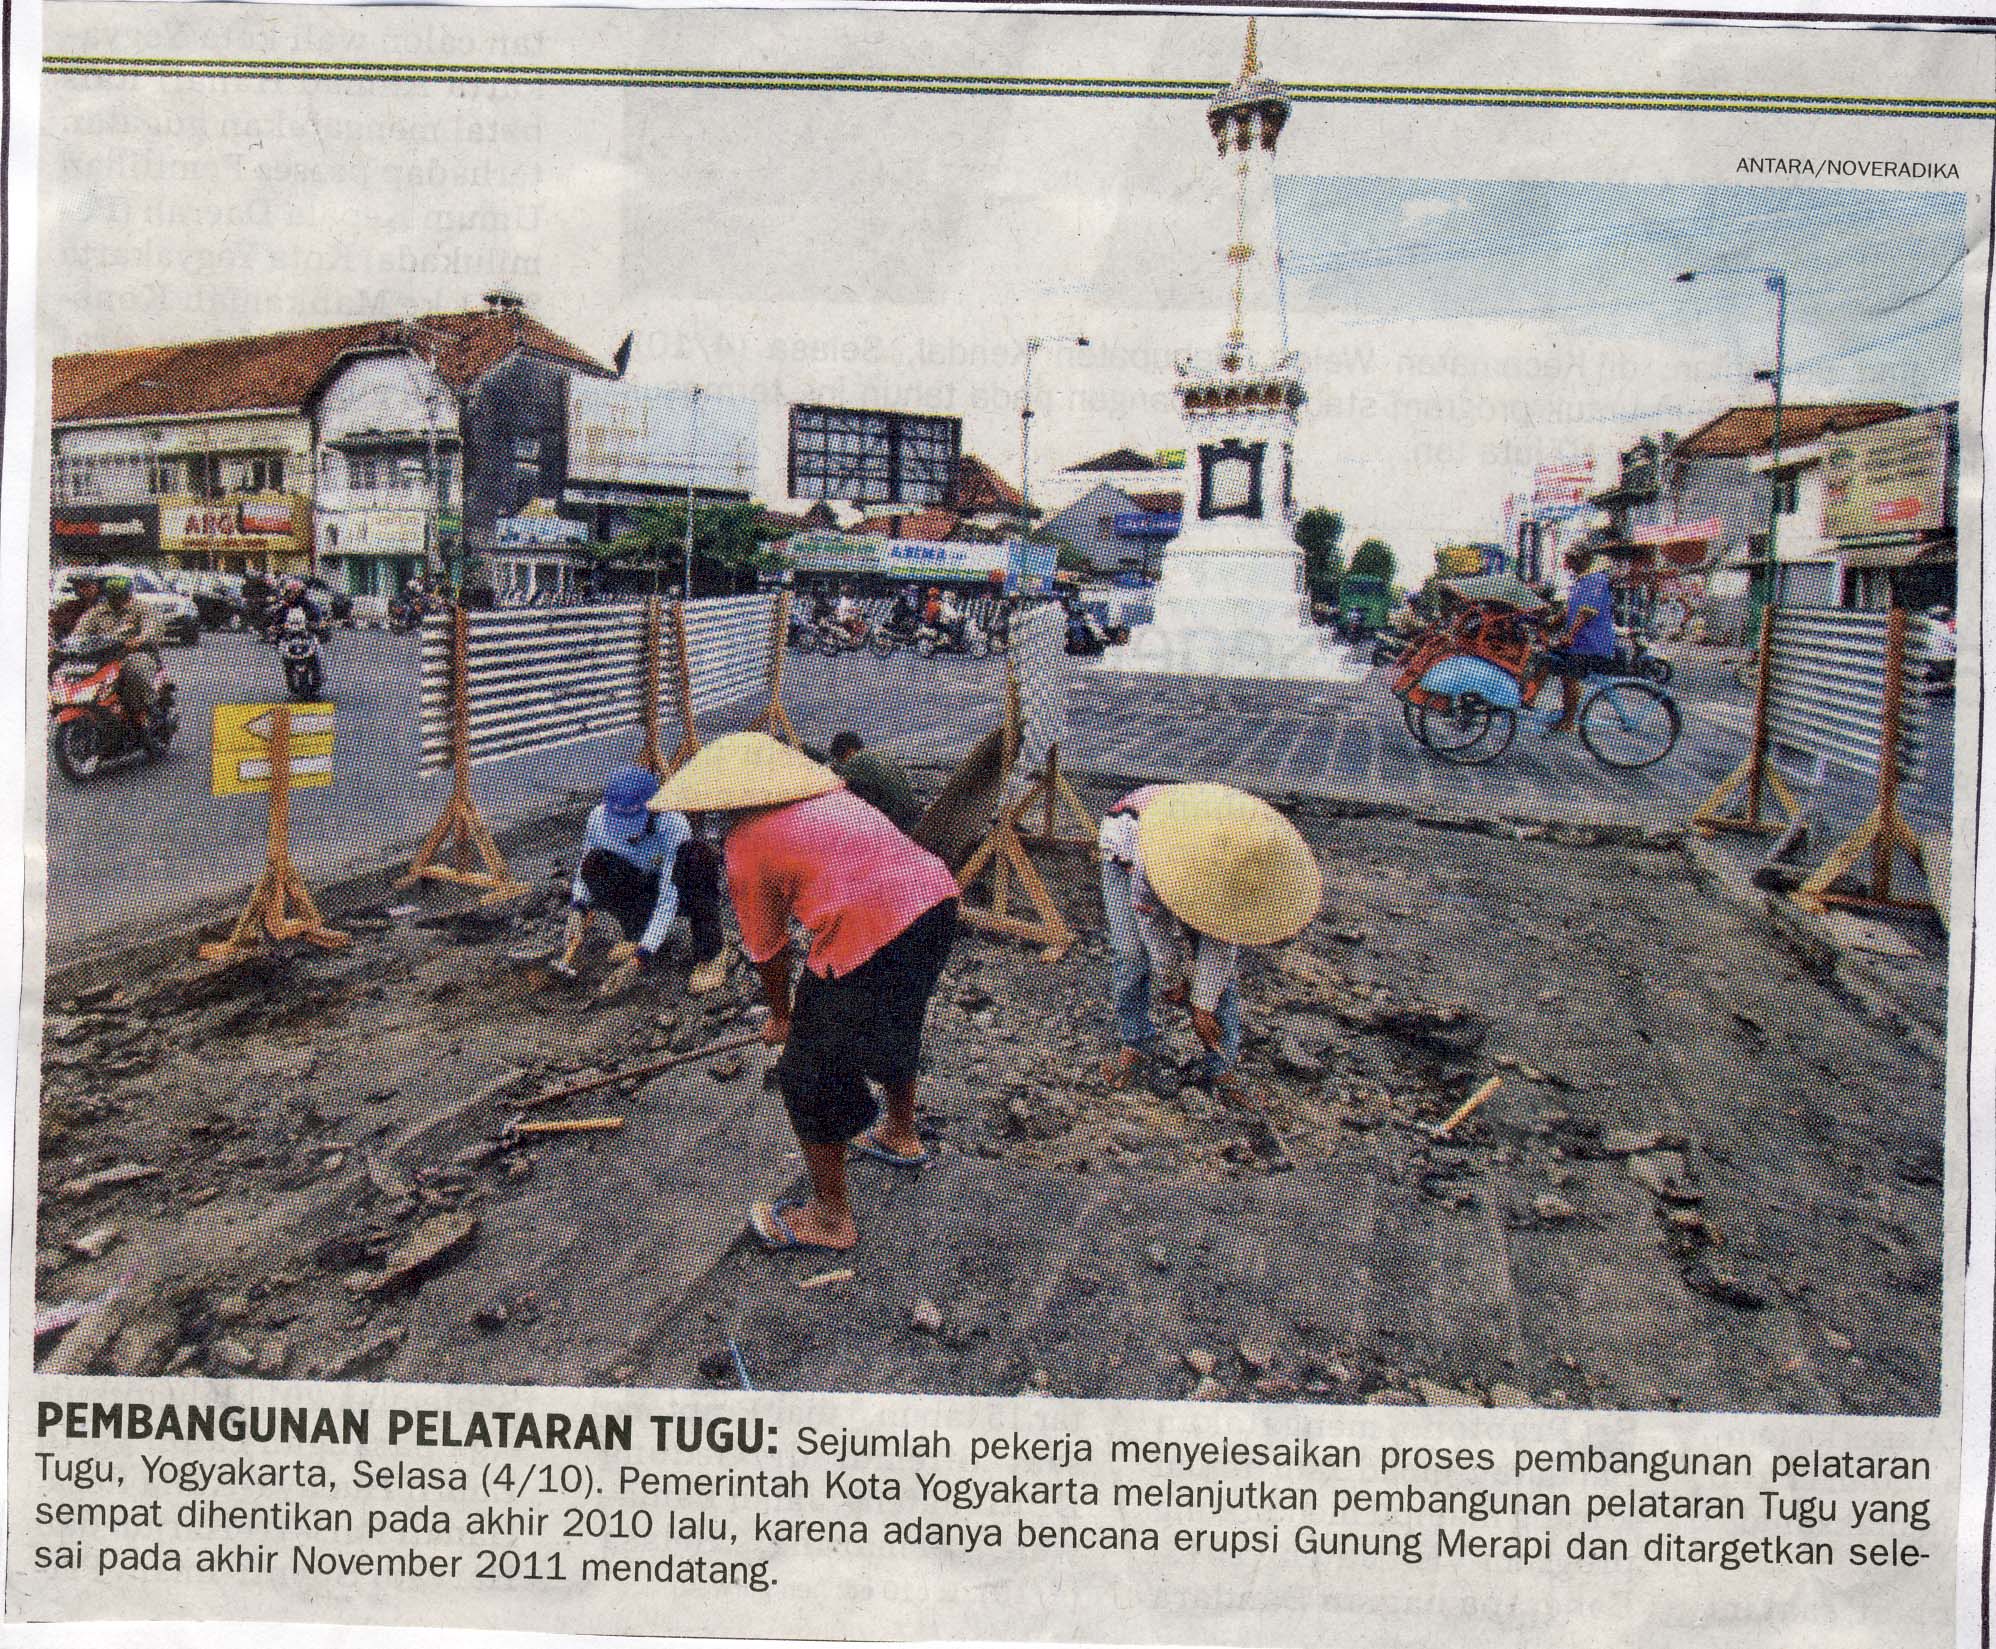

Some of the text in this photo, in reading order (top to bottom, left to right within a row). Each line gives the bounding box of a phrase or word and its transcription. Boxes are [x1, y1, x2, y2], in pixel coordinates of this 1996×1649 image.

[1736, 157, 1959, 179] ANTARA/NOVERADIKA
[37, 1401, 369, 1445] PEMBANGUNAN
[388, 1409, 632, 1451] PELATARAN
[649, 1415, 778, 1455] TUGU:
[796, 1426, 951, 1463] Sejumlah
[971, 1431, 1092, 1468] pekerja
[1381, 1446, 1495, 1475] proses
[1515, 1444, 1752, 1482] pembangunan
[1772, 1449, 1930, 1483] pelataran
[34, 1452, 1931, 1531] Tugu, Yogyakarta, Selasa (4/10). Pemerintah Kota Yogyakarta melanjutkan pembangunan pelataran Tugu yang
[34, 1540, 778, 1593] sai pada akhir November 2011 mendatang.
[35, 1499, 1930, 1571] sempat dihentikan pada akhir 2010 lalu, karena adanya bencana erupsi Gunung Merapi dan ditargetkan sele-
